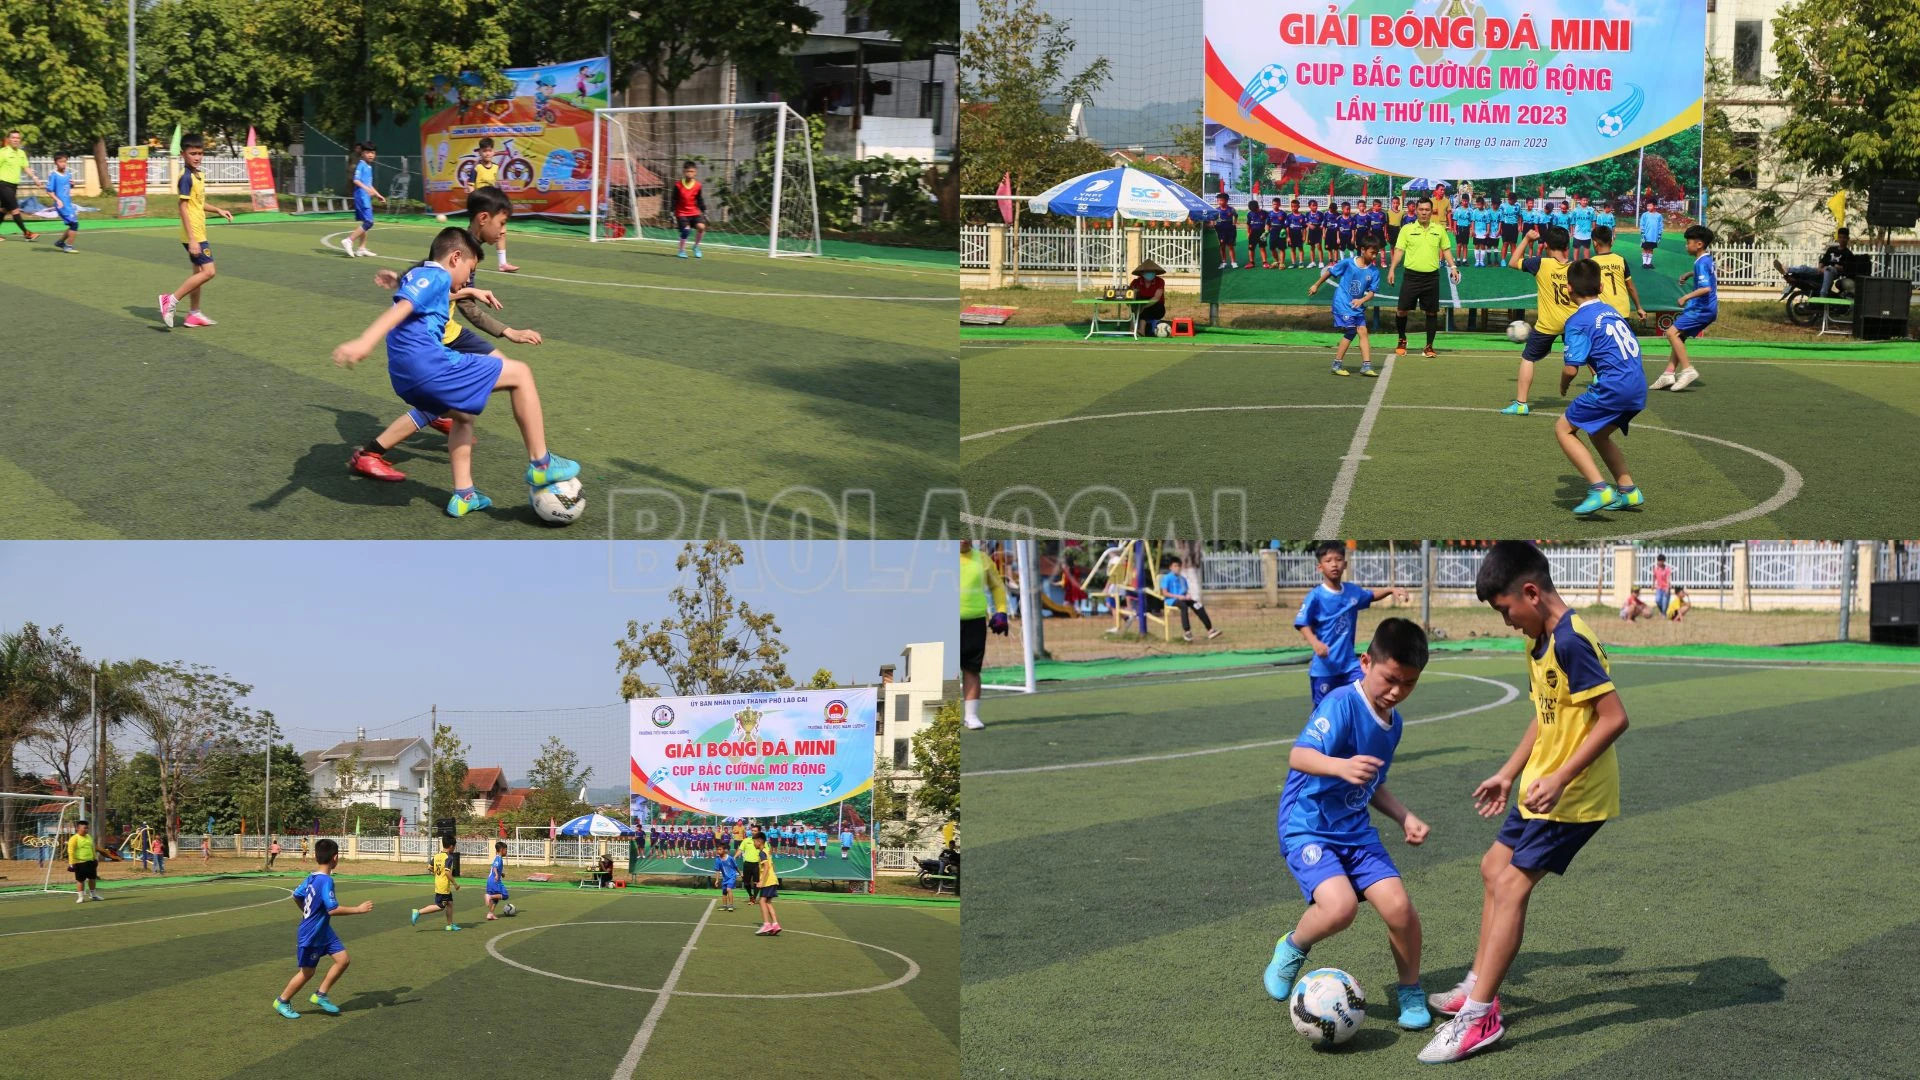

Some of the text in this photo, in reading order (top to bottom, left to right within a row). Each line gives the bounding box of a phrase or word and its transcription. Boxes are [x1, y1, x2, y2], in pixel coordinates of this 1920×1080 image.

[1280, 5, 1631, 51] GIẢI BÓNG ĐÁ MINI
[1296, 56, 1612, 95] CUP BẮC CƯỜNG MỞ RỘNG
[1336, 95, 1567, 125] LẦN THỨ III, NĂM 2023
[1440, 137, 1451, 146] 17
[1484, 137, 1497, 147] 03
[1524, 137, 1548, 148] 2023
[1552, 282, 1571, 306] 15
[1604, 272, 1617, 296] 7
[1605, 320, 1639, 360] 18
[665, 739, 835, 758] GIẢI BÓNG ĐÁ MINI
[672, 765, 695, 776] CUP
[699, 761, 721, 775] BẮC
[725, 761, 765, 775] CƯỜNG
[792, 761, 826, 777] RỘNG
[778, 781, 803, 791] 2023
